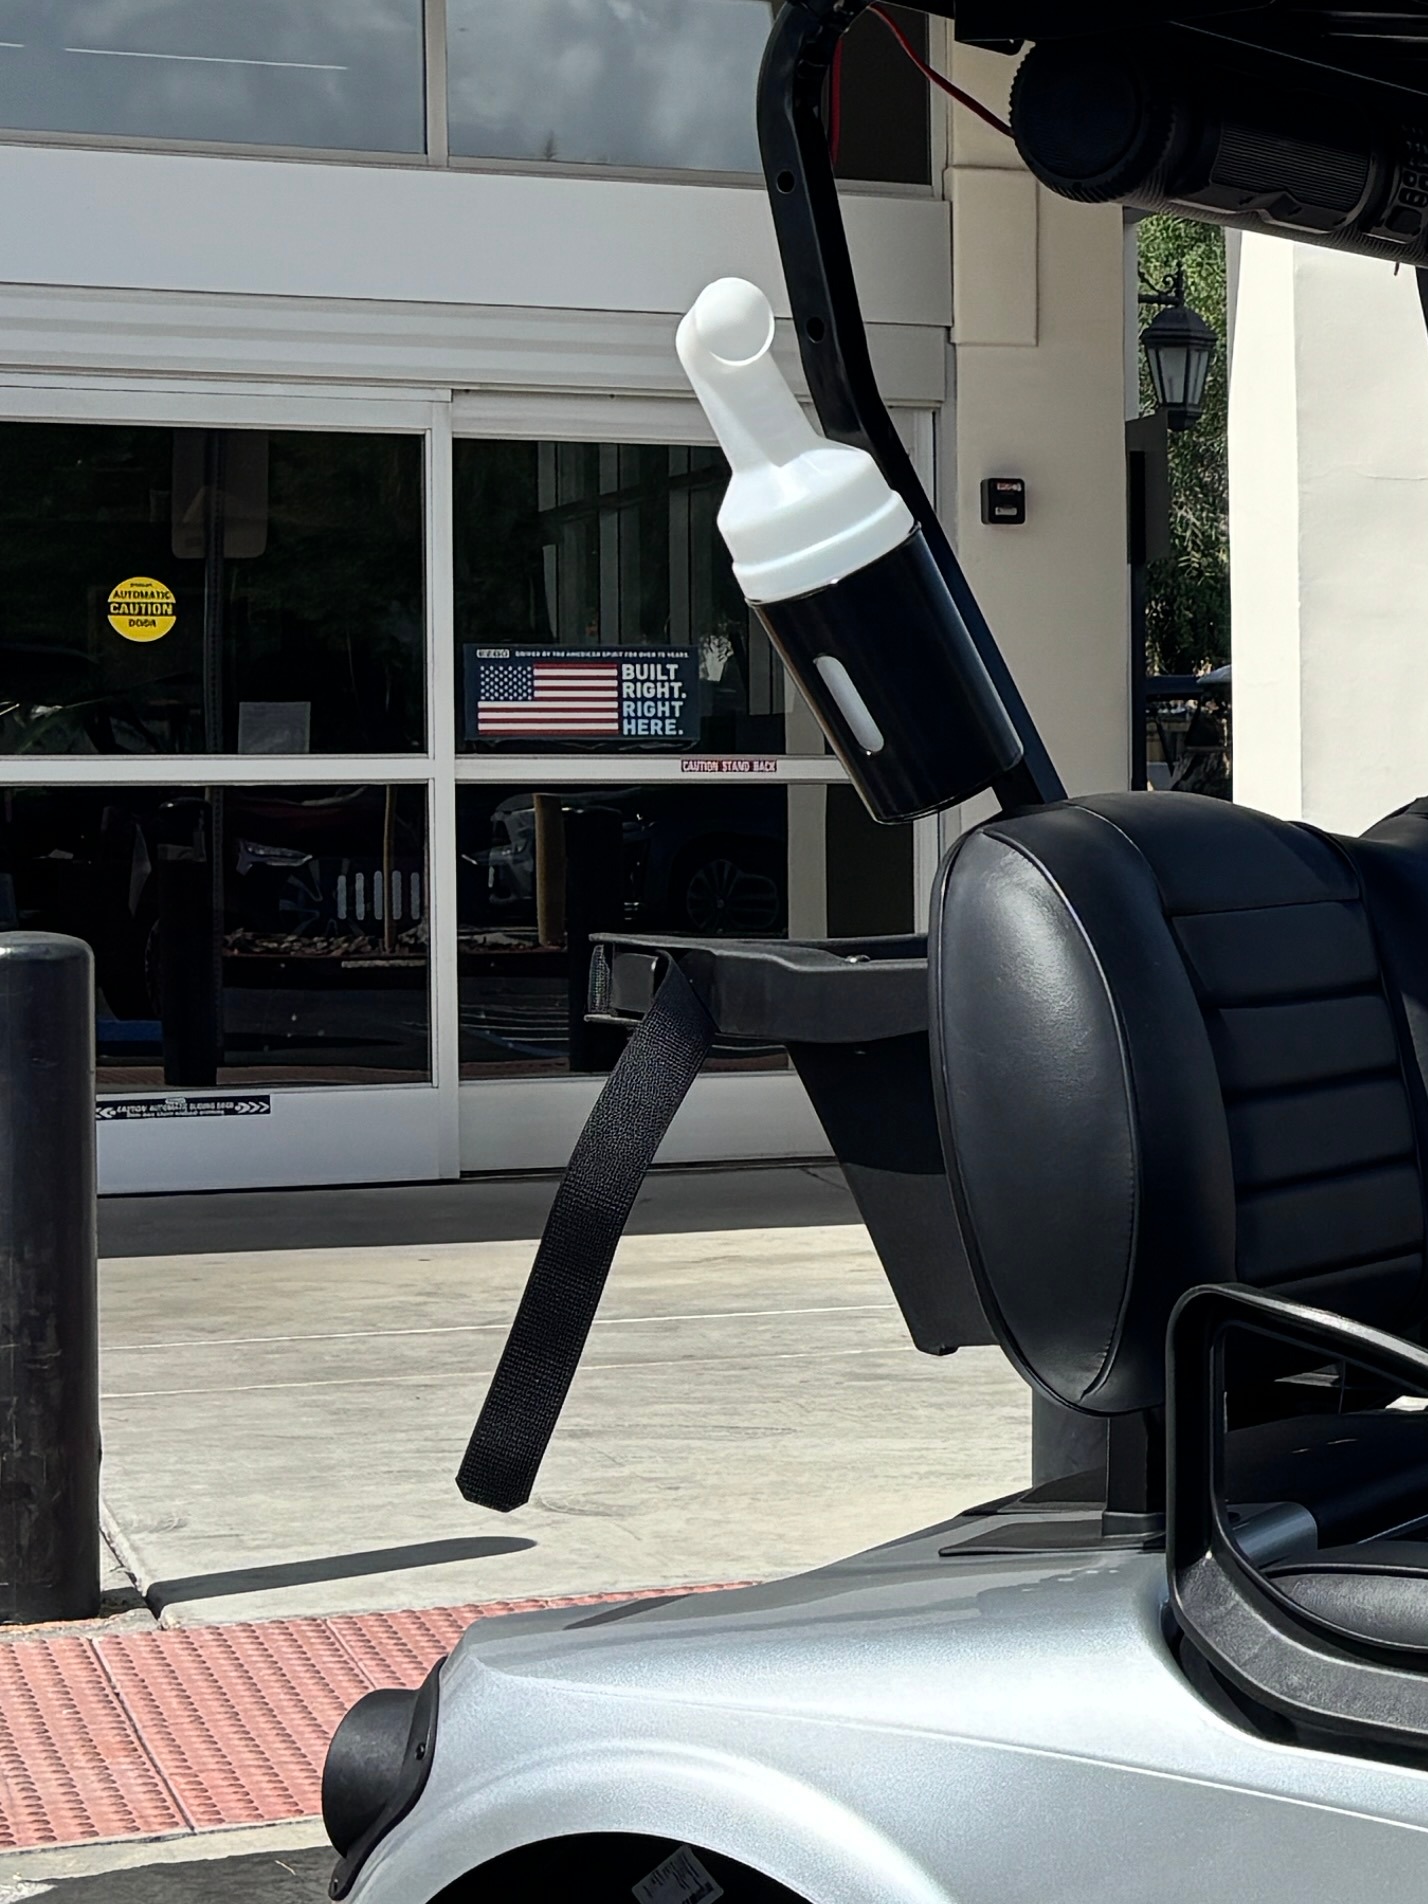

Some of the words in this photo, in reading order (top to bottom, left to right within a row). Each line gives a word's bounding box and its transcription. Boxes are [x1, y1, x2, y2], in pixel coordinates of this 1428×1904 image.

[112, 590, 171, 600] AUTOMATIC
[109, 603, 173, 615] CAUTION
[621, 664, 678, 680] BUILT
[622, 682, 687, 699] RIGHT.
[622, 701, 684, 718] RIGHT
[622, 719, 684, 735] HERE.
[683, 760, 718, 771] CAUTION
[722, 760, 750, 772] STAND
